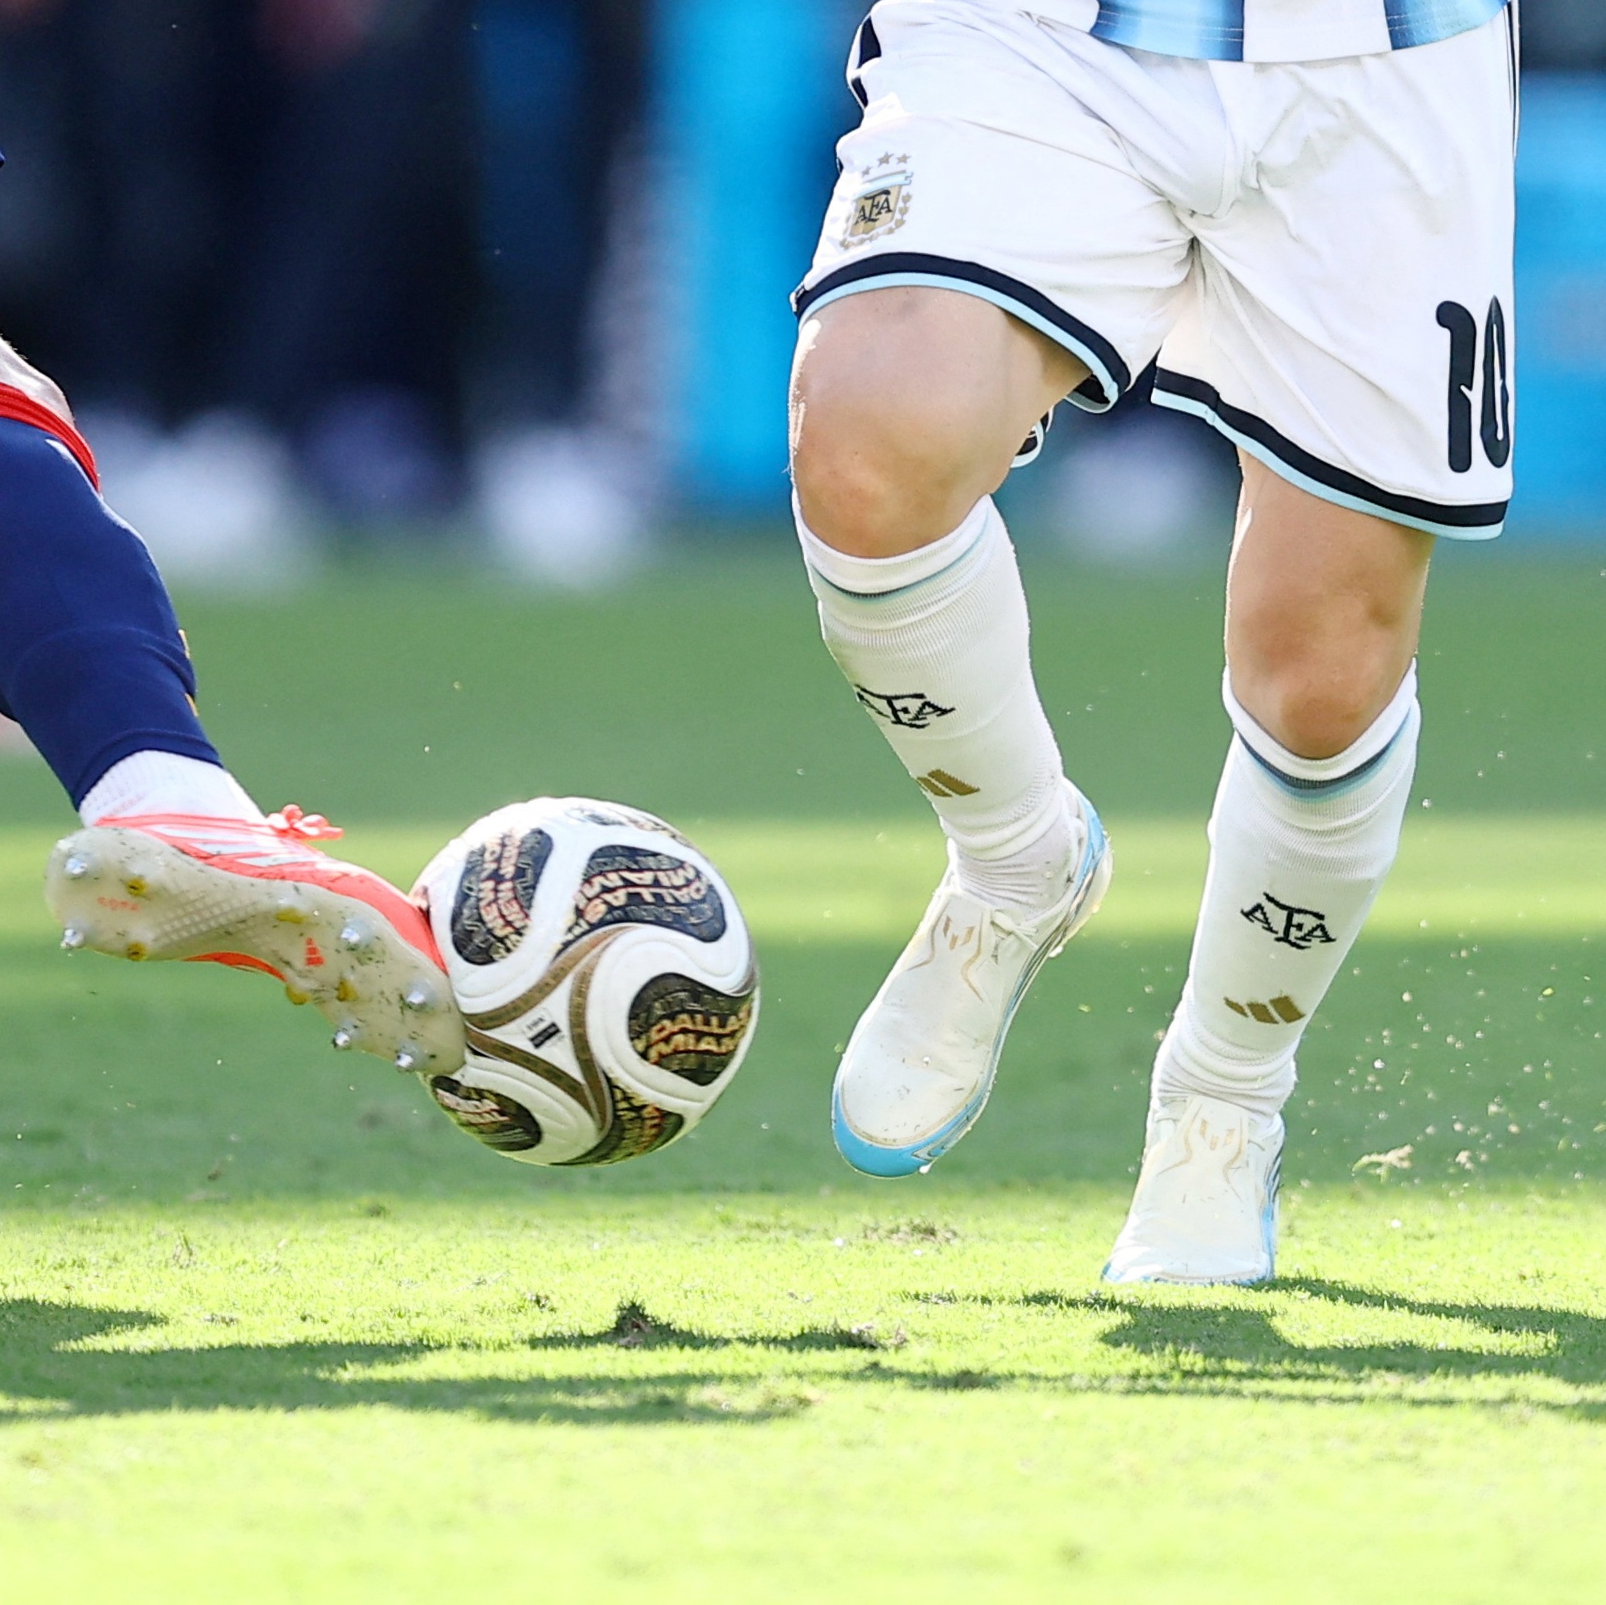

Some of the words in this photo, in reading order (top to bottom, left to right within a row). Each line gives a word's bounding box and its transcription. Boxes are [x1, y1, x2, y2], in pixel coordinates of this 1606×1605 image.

[854, 189, 893, 225] AFA
[1435, 295, 1510, 474] 10
[1240, 891, 1336, 950] AFA
